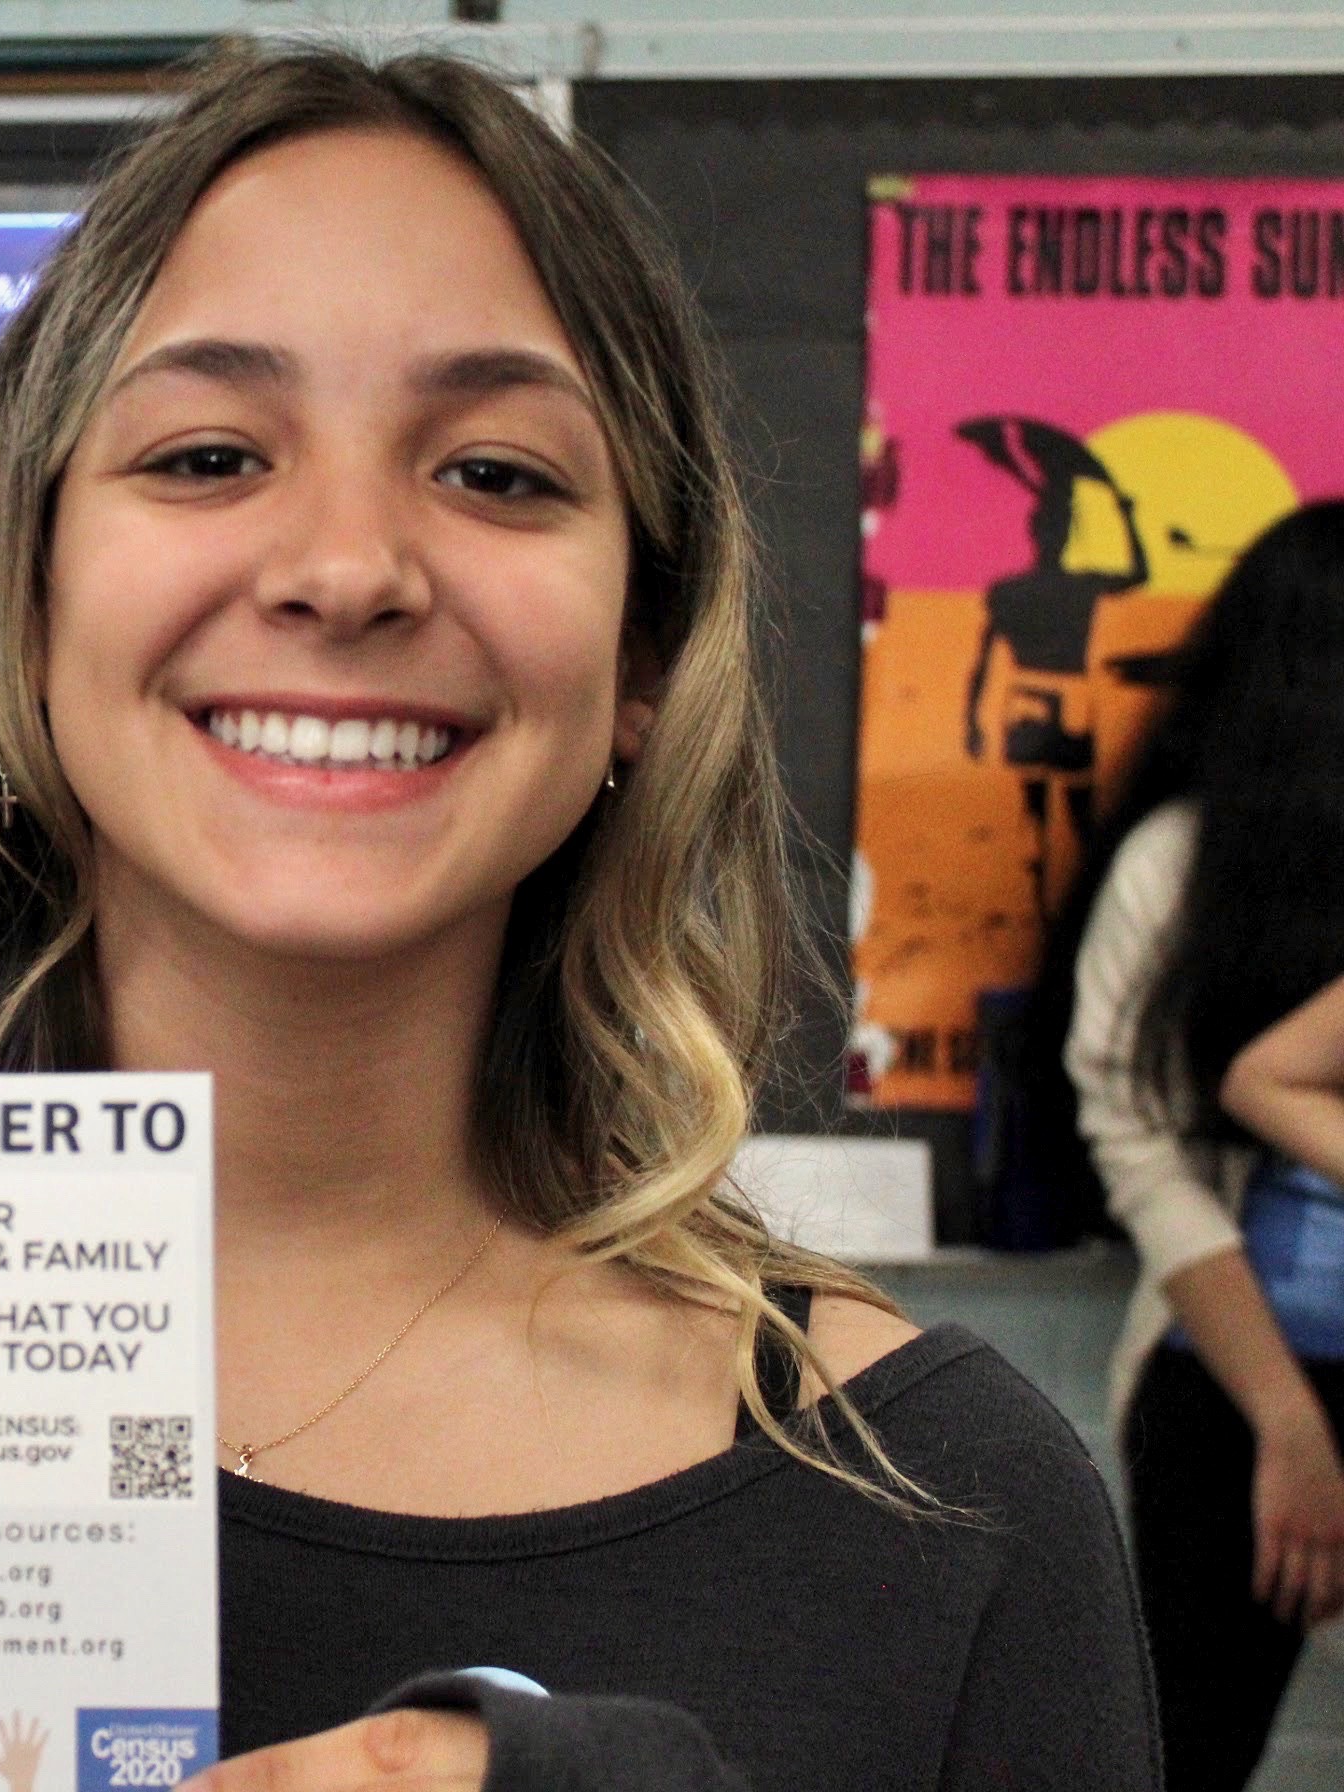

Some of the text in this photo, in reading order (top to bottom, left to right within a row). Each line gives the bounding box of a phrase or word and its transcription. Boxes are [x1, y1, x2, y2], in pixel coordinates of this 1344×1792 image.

[895, 202, 983, 298] THE
[1005, 204, 1230, 300] ENDLESS
[101, 1100, 188, 1154] TO
[23, 1241, 169, 1271] FAMILY
[82, 1302, 170, 1333] YOU
[1, 1341, 143, 1373] TODAY
[91, 1727, 198, 1760] Census
[109, 1757, 182, 1786] 2020
